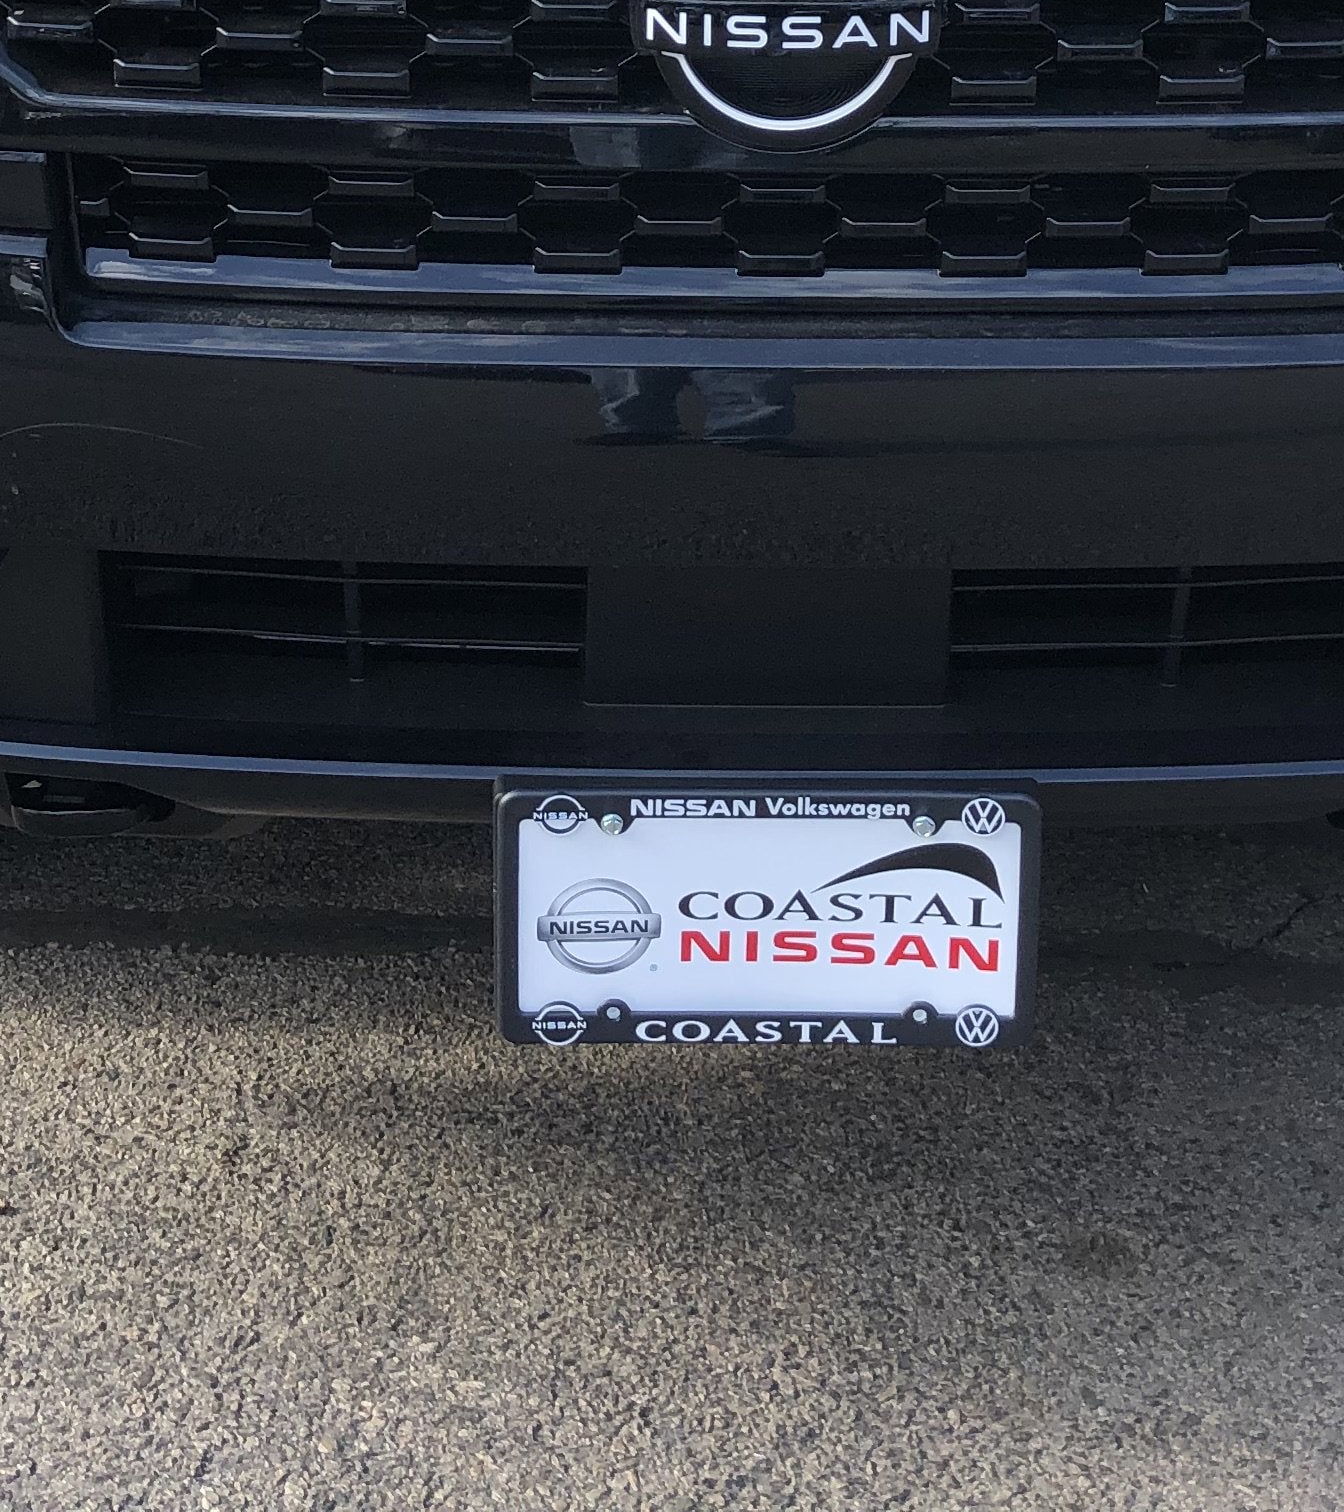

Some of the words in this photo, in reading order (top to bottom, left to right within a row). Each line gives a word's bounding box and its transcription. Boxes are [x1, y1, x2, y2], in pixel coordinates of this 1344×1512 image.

[644, 8, 930, 50] NISSAN
[533, 811, 588, 820] NISSAN
[630, 798, 756, 817] NISSAN
[764, 797, 911, 819] Volkswagen
[678, 889, 1003, 929] COASTAL
[549, 919, 649, 935] NISSAN
[680, 930, 1000, 972] NISSAN
[532, 1021, 587, 1030] NISSAN
[635, 1018, 897, 1044] COASTAL
